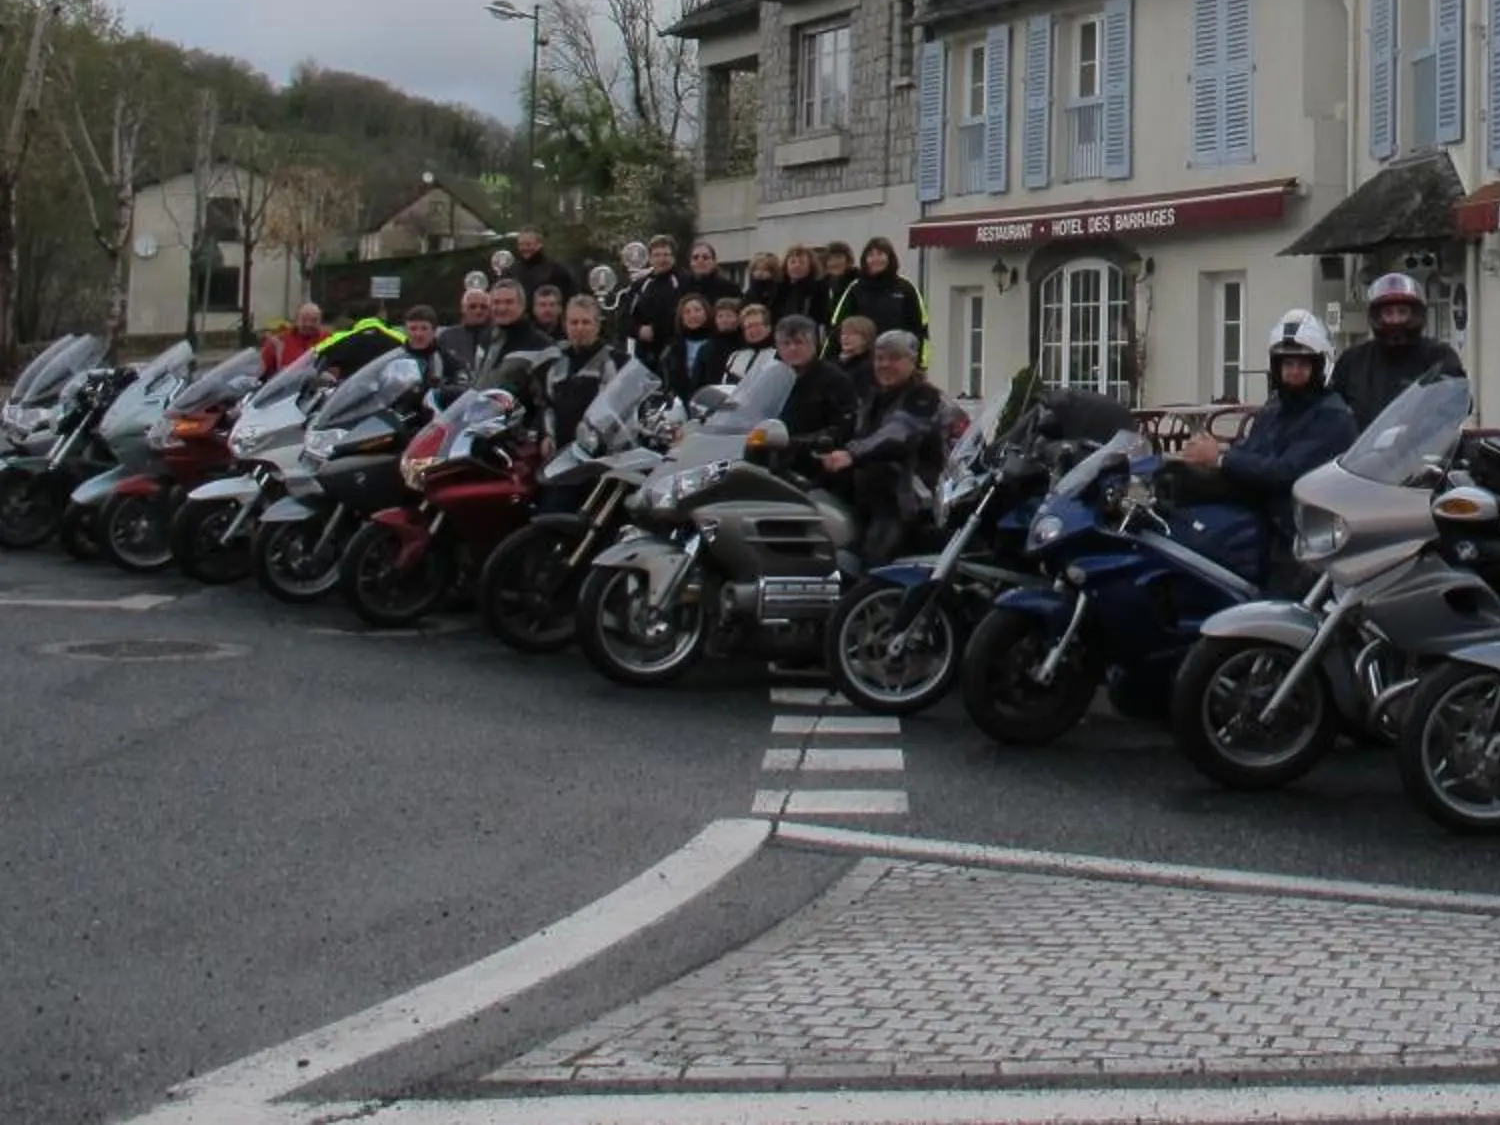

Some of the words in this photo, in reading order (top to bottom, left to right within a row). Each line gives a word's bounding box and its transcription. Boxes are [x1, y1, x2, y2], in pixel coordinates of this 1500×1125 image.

[976, 223, 1034, 243] RESTAURANT
[1051, 218, 1085, 236] HOTEL
[1088, 215, 1111, 235] DES
[1114, 208, 1176, 231] BARRAGES
